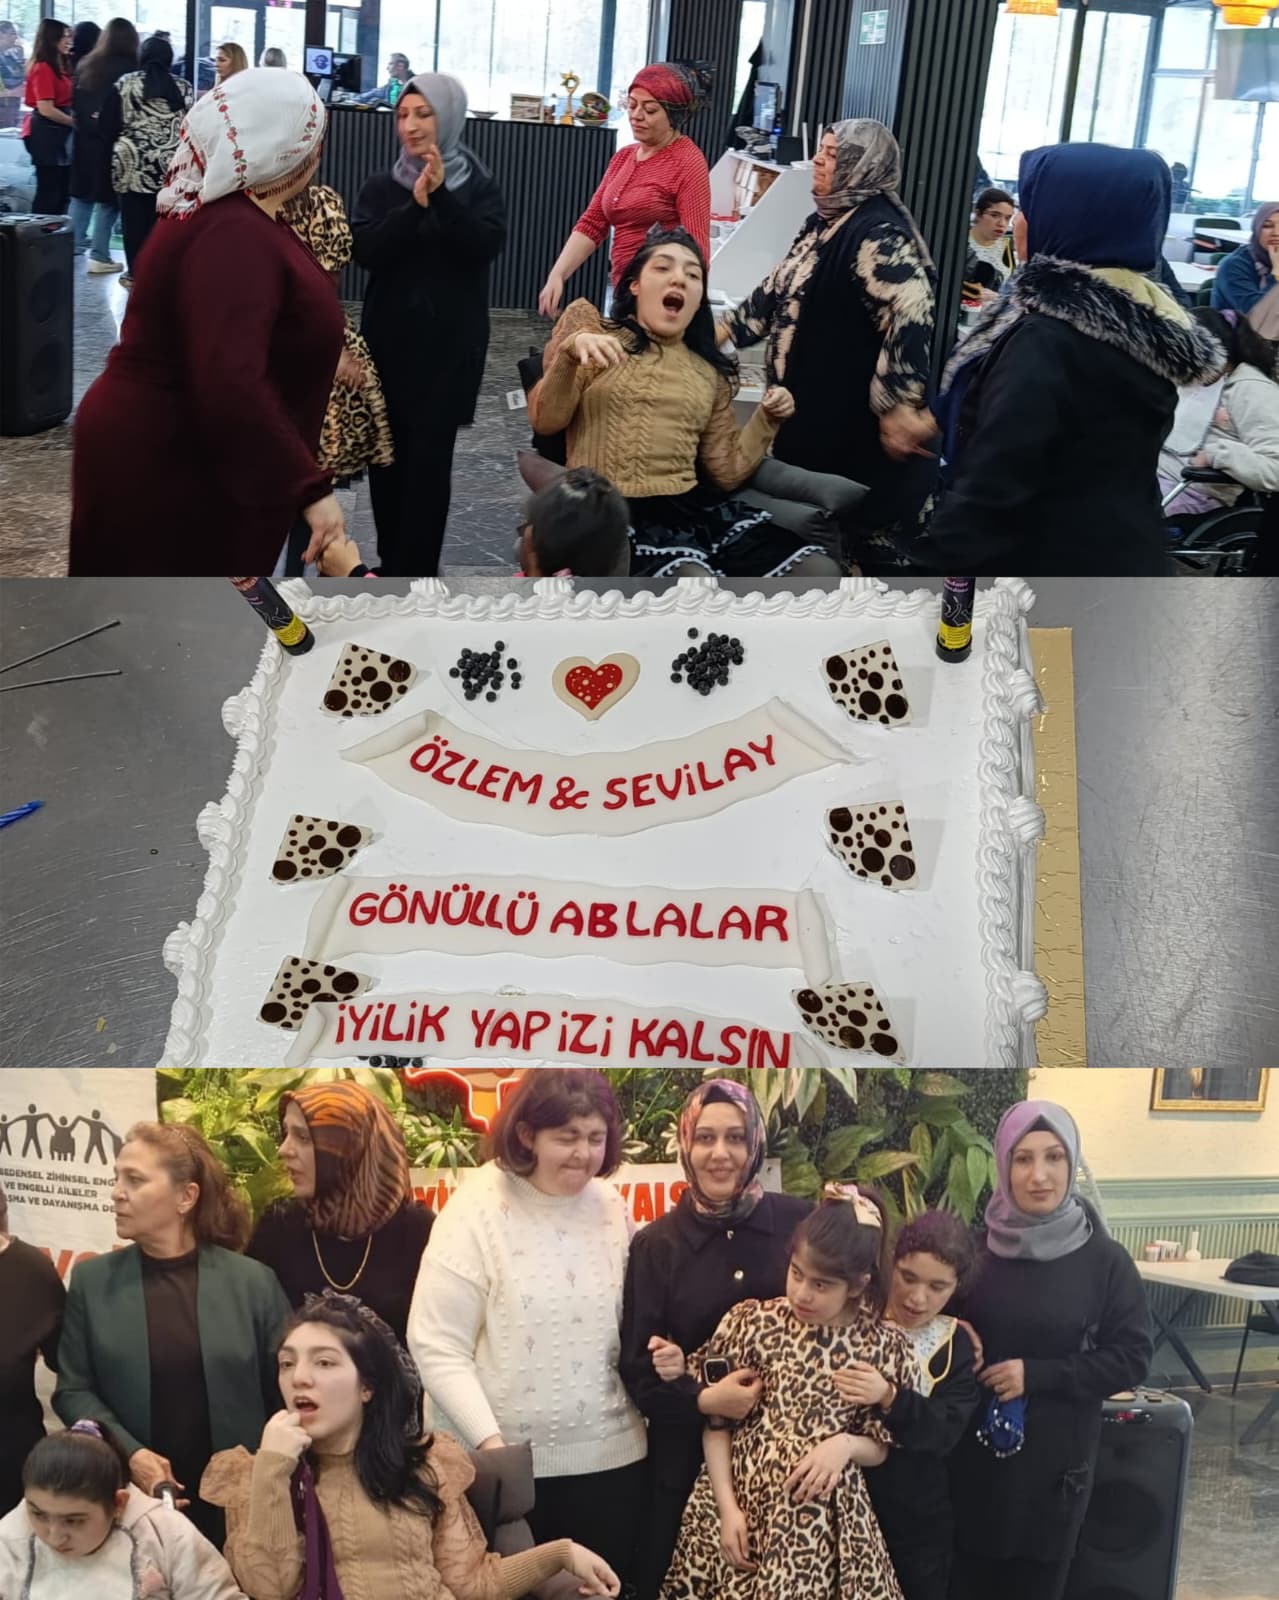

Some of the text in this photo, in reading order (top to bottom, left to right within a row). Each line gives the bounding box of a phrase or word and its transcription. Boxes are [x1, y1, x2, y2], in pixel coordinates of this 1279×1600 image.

[409, 735, 776, 811] ÖZLEM & SEVİLAY
[348, 883, 789, 943] GÖNÜLLÜ ABLALAR
[335, 1001, 792, 1068] İYİLİK YAP İZİ KALSIN
[4, 1181, 98, 1198] VE ENGELLİ AİLELER
[28, 1196, 40, 1206] VE
